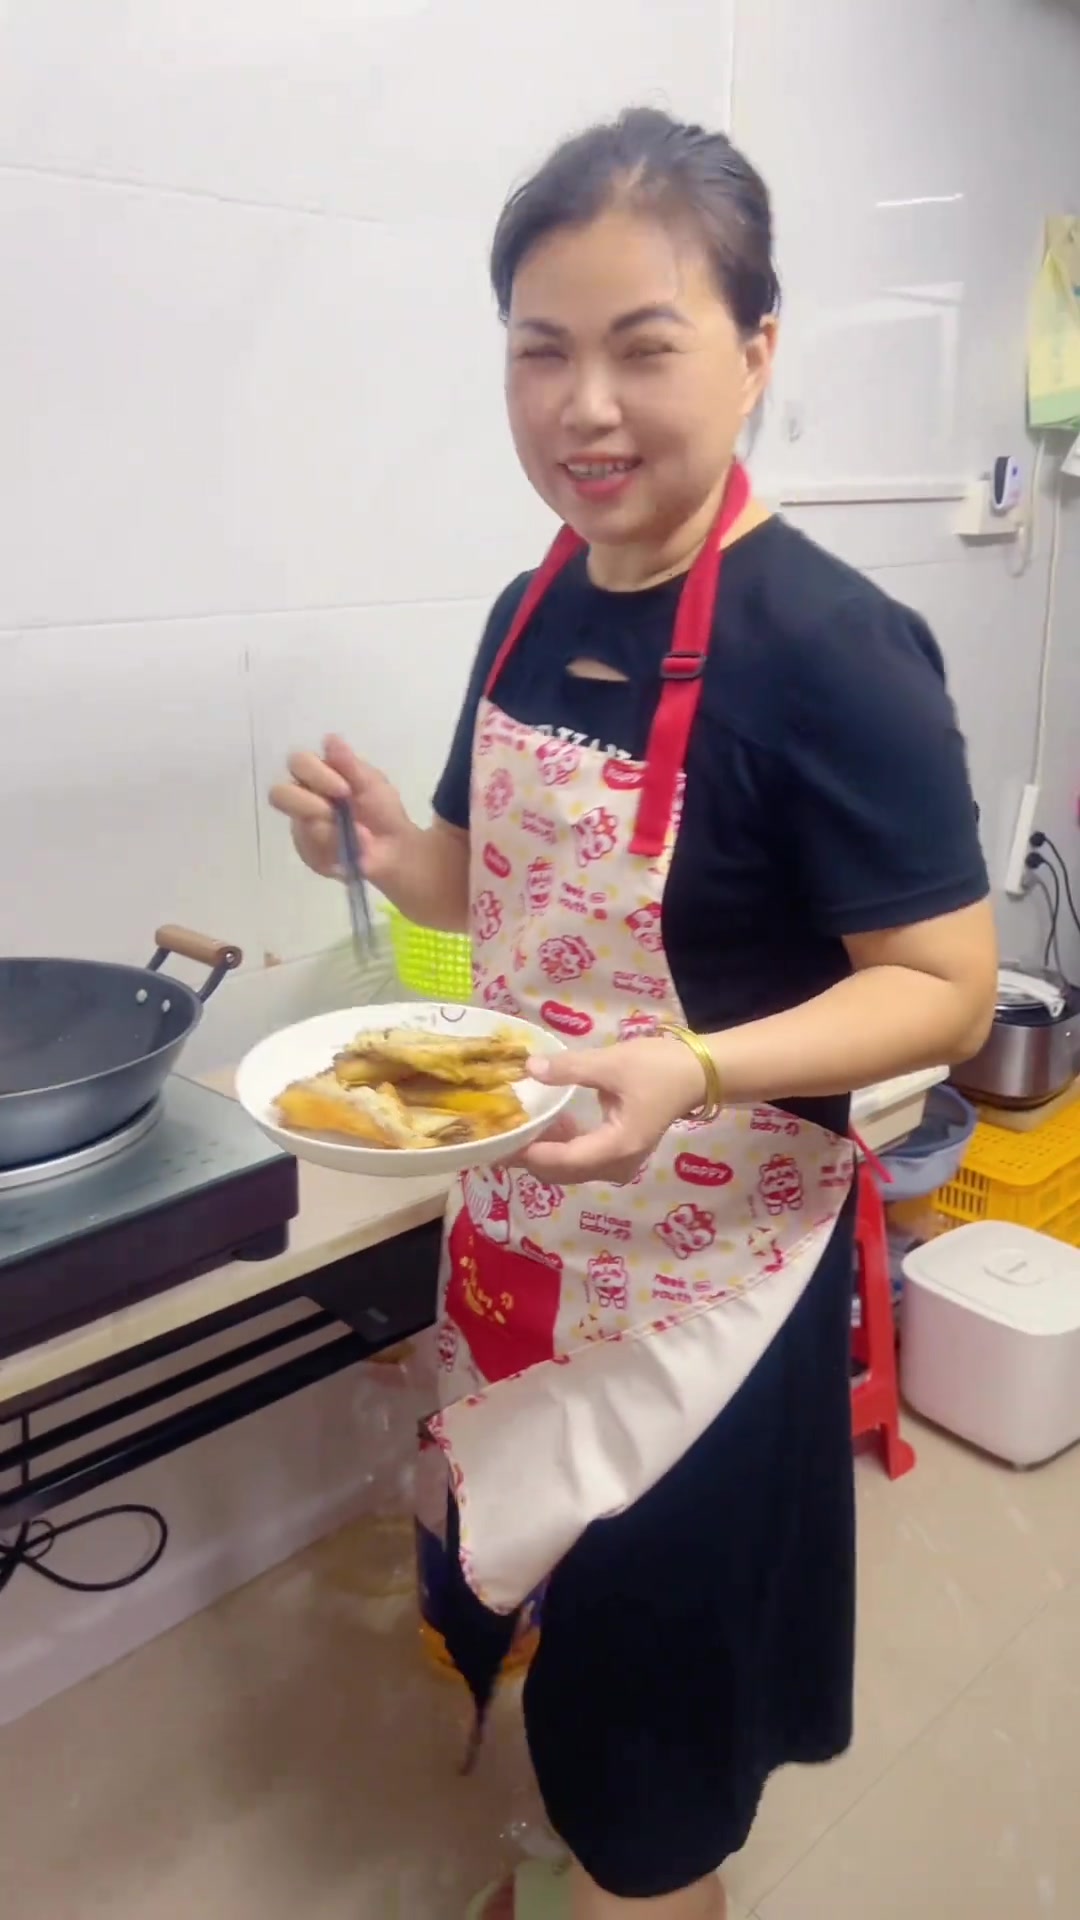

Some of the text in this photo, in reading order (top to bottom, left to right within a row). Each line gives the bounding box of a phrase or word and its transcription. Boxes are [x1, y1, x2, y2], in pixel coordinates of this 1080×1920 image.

[544, 1007, 590, 1030] happy
[680, 1160, 729, 1180] happy
[579, 1219, 609, 1236] baby
[580, 1210, 632, 1228] curious
[652, 1289, 692, 1304] youth
